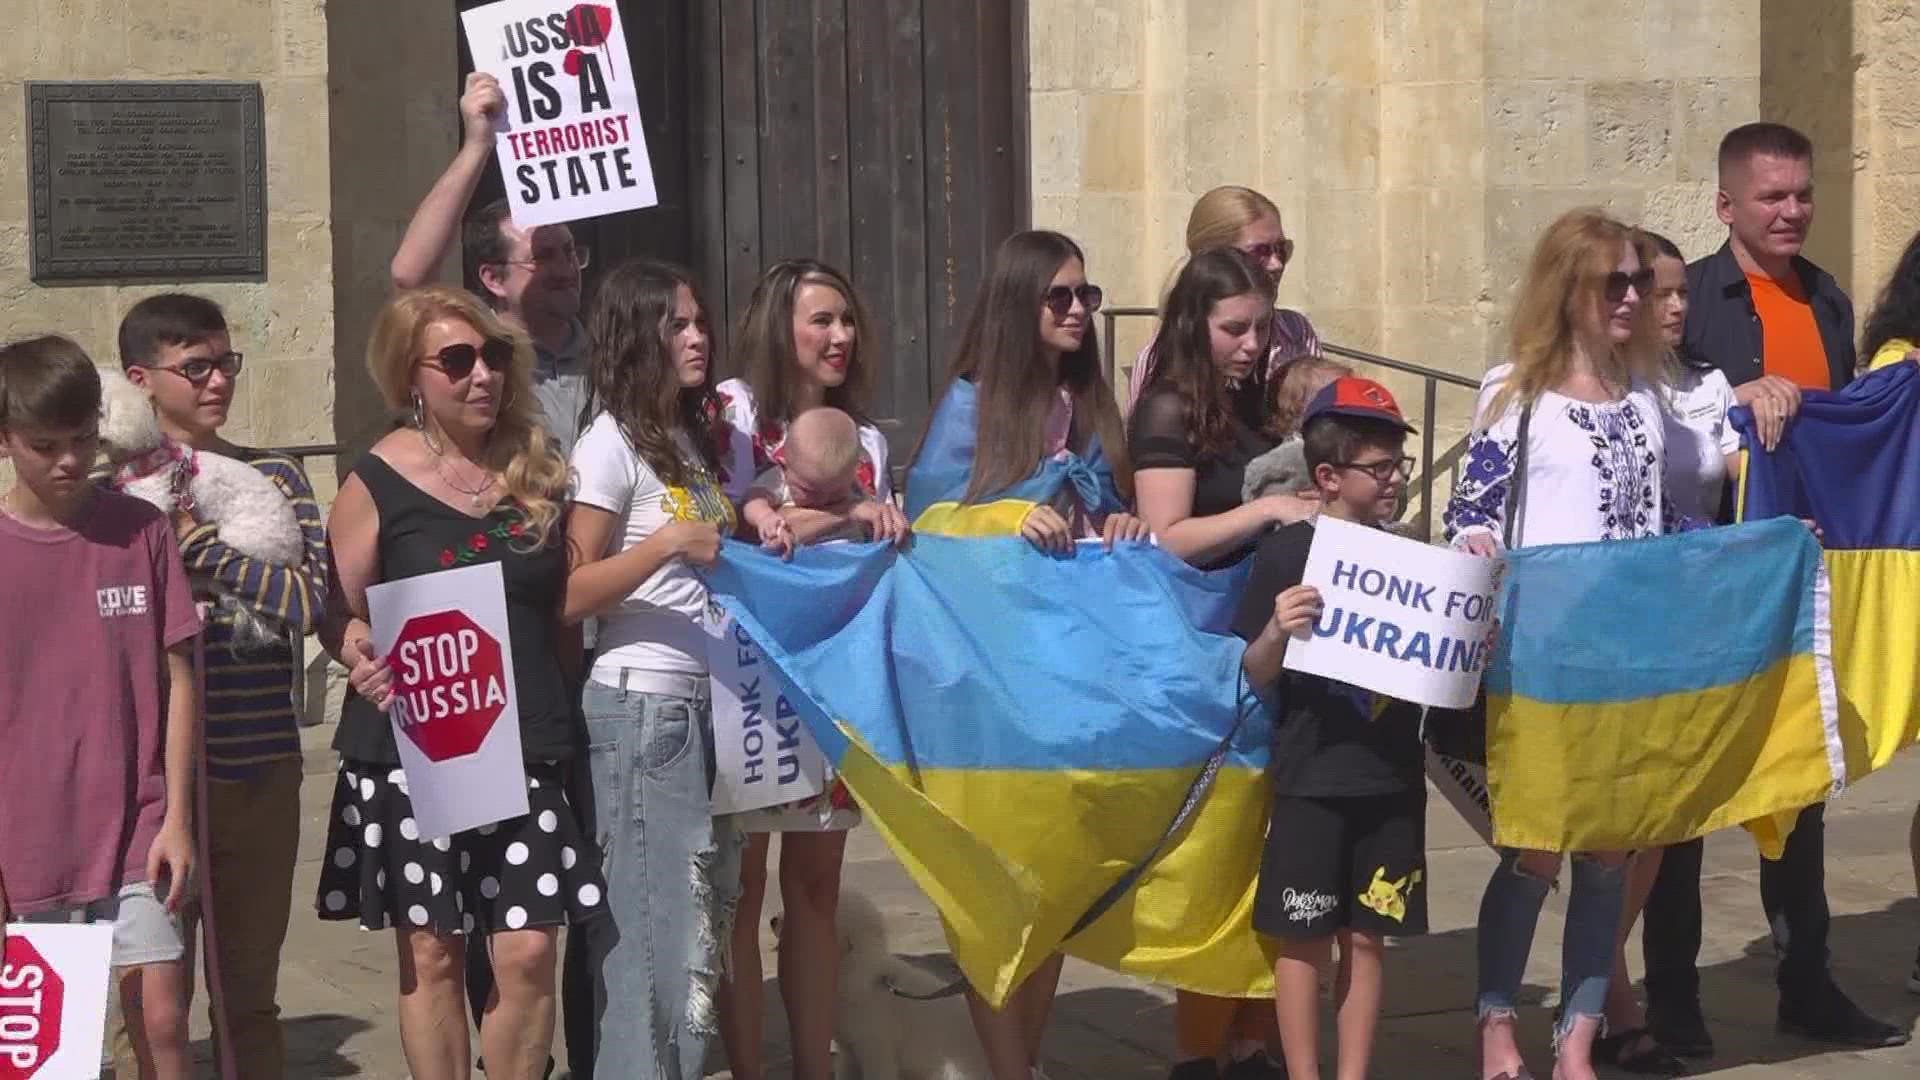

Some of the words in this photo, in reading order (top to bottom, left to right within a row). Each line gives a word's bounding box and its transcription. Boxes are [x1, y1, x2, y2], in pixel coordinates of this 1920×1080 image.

[502, 5, 606, 60] USSIA
[511, 61, 562, 125] IS
[577, 53, 612, 114] A
[507, 114, 631, 160] TERRORIST
[516, 147, 637, 205] STATE
[96, 585, 146, 608] COVE
[1332, 560, 1437, 612] HONK
[1444, 592, 1494, 622] FOR
[400, 629, 479, 686] STOP
[391, 674, 506, 728] RUSSIA
[740, 676, 764, 784] HONK
[0, 964, 44, 1068] STOP
